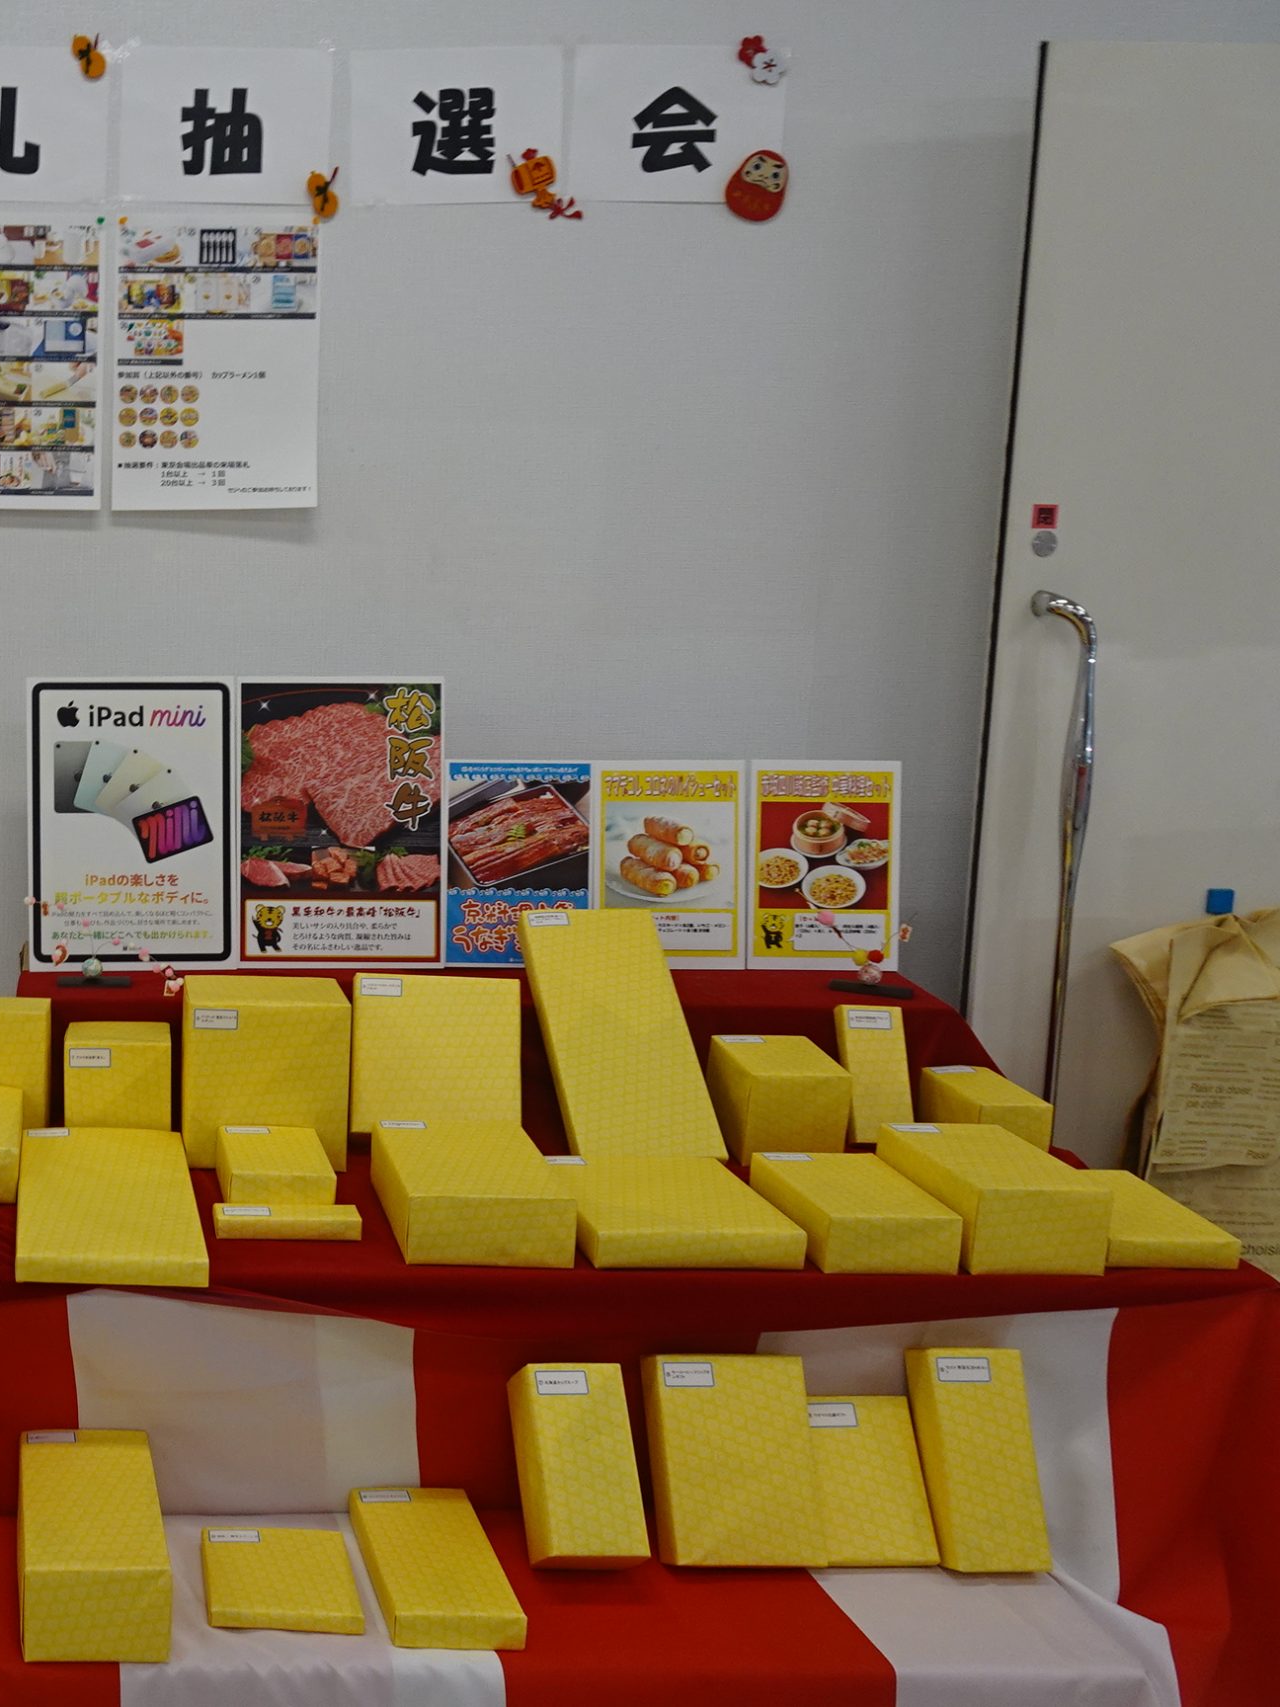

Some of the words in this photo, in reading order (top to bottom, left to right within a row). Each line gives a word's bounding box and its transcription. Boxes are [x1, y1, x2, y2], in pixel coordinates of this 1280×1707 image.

[88, 705, 144, 727] iPad
[150, 705, 207, 727] mini
[384, 687, 434, 830] 松阪牛
[85, 874, 179, 886] iPadの楽しさを
[55, 892, 209, 905] 超ポータブルなボディに。
